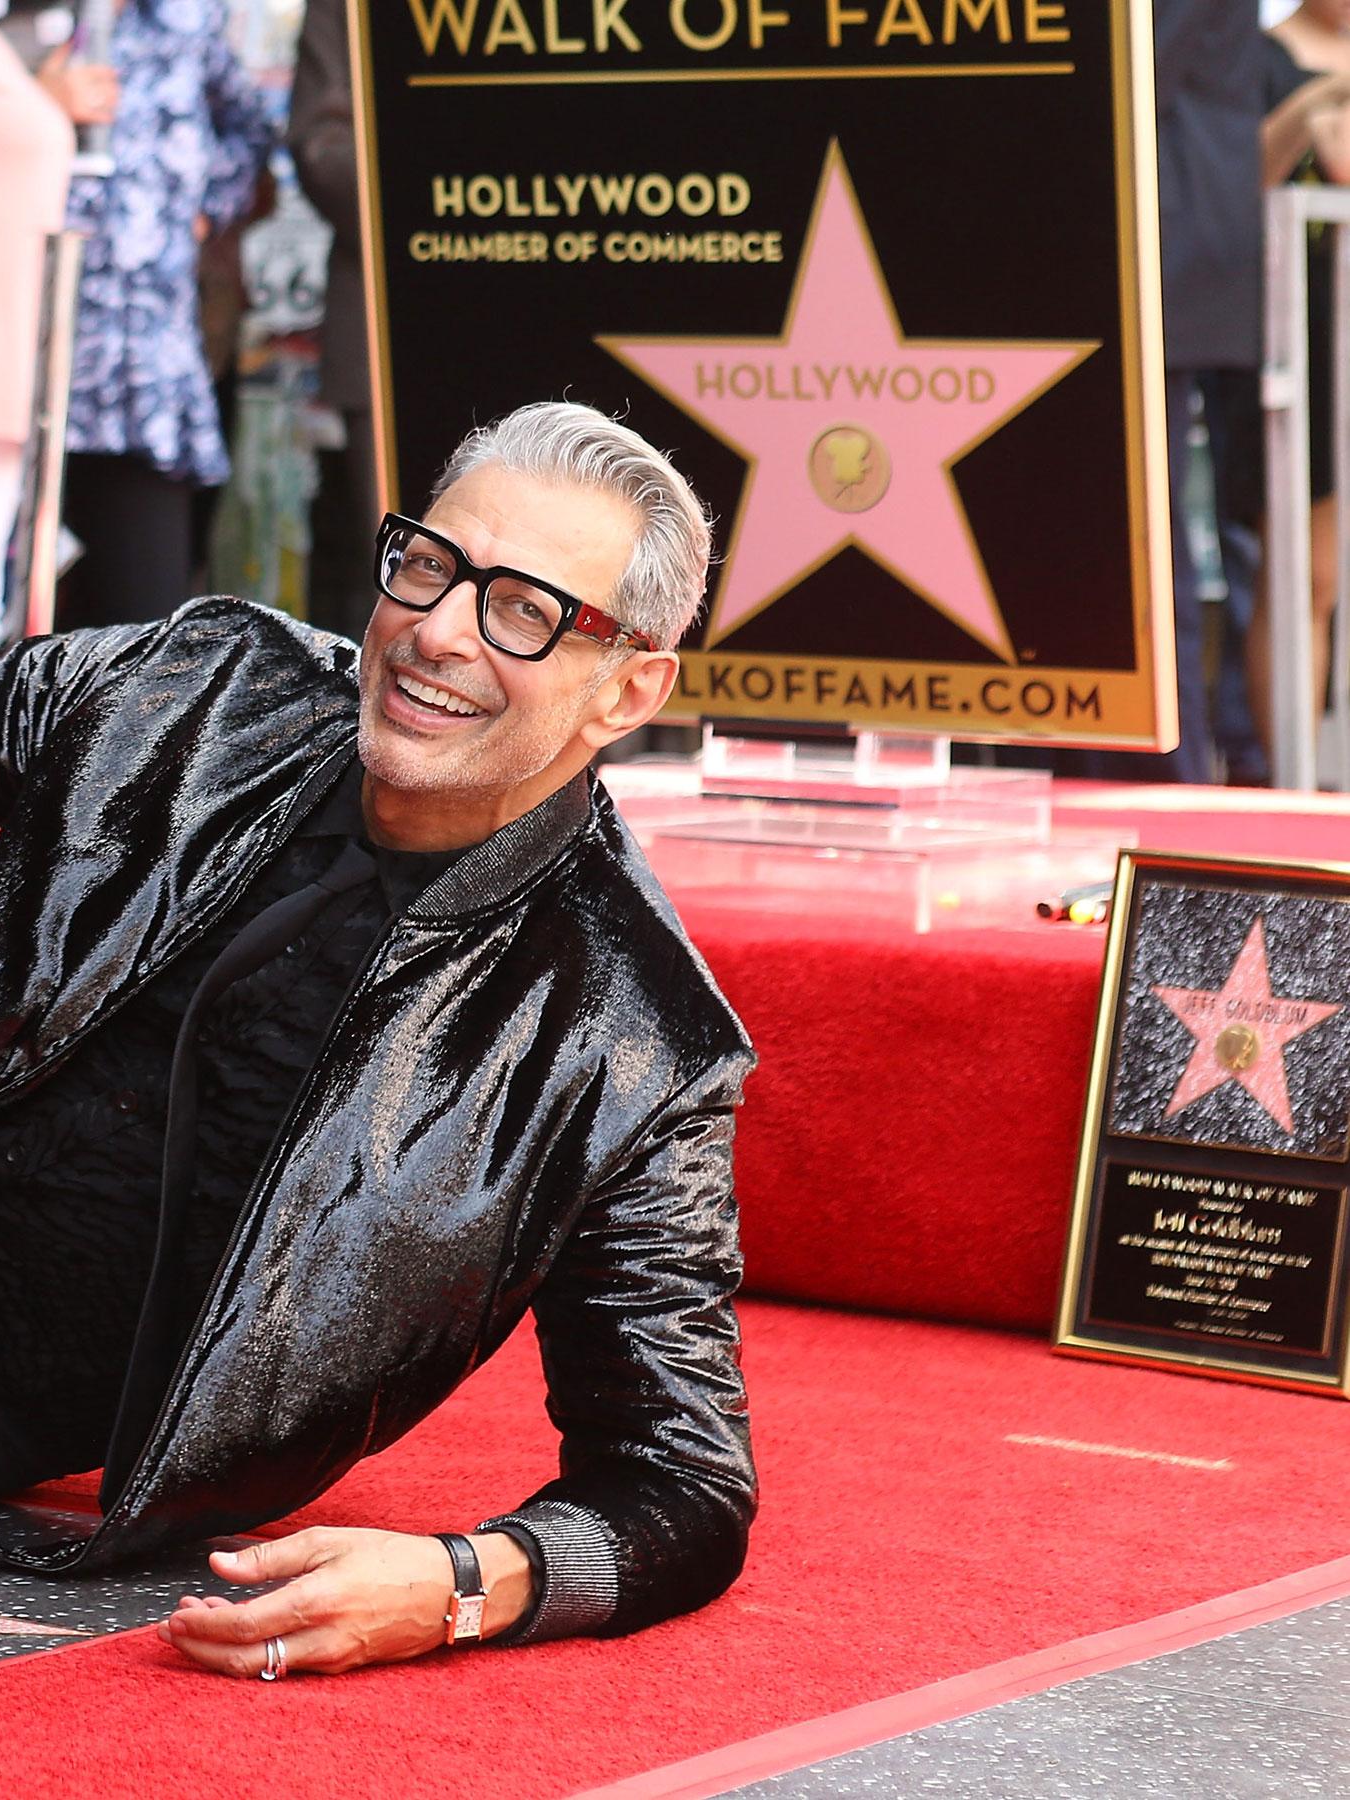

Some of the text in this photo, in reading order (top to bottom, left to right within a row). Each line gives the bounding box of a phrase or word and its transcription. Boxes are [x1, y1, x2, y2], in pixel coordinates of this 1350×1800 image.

[412, 0, 1072, 56] WALK OF FAME
[432, 173, 751, 217] HOLLYWOOD
[408, 231, 784, 263] CHAMBER OF COMMERCE
[695, 361, 997, 403] HOLLYWOOD
[678, 662, 1104, 721] LKOFFAME.COM
